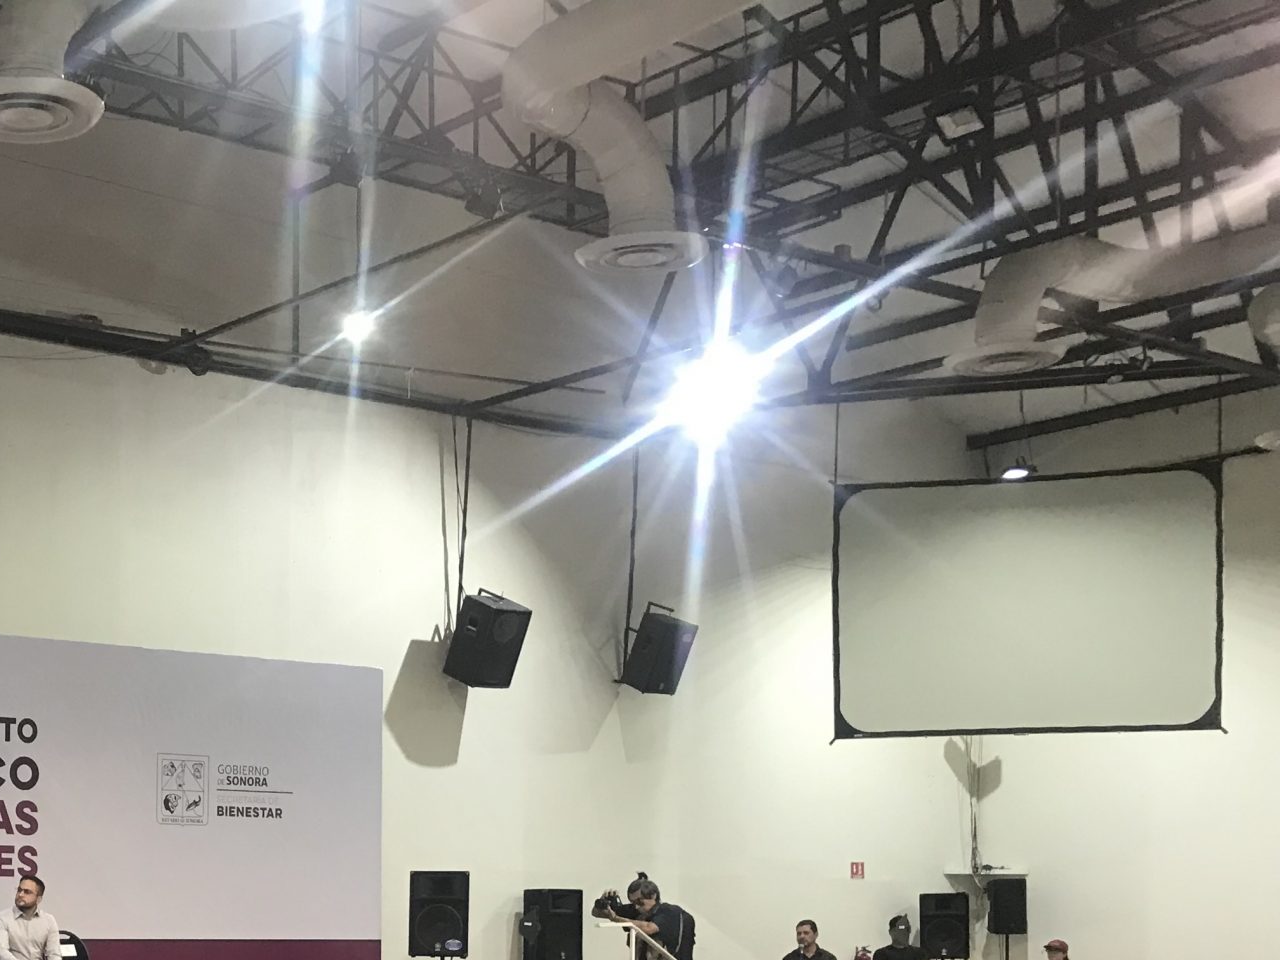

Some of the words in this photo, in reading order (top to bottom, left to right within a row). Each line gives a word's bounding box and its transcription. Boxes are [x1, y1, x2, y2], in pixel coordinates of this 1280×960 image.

[217, 763, 270, 777] GOBIERNO
[226, 775, 269, 788] SONORA
[216, 805, 283, 819] BIENESTAR
